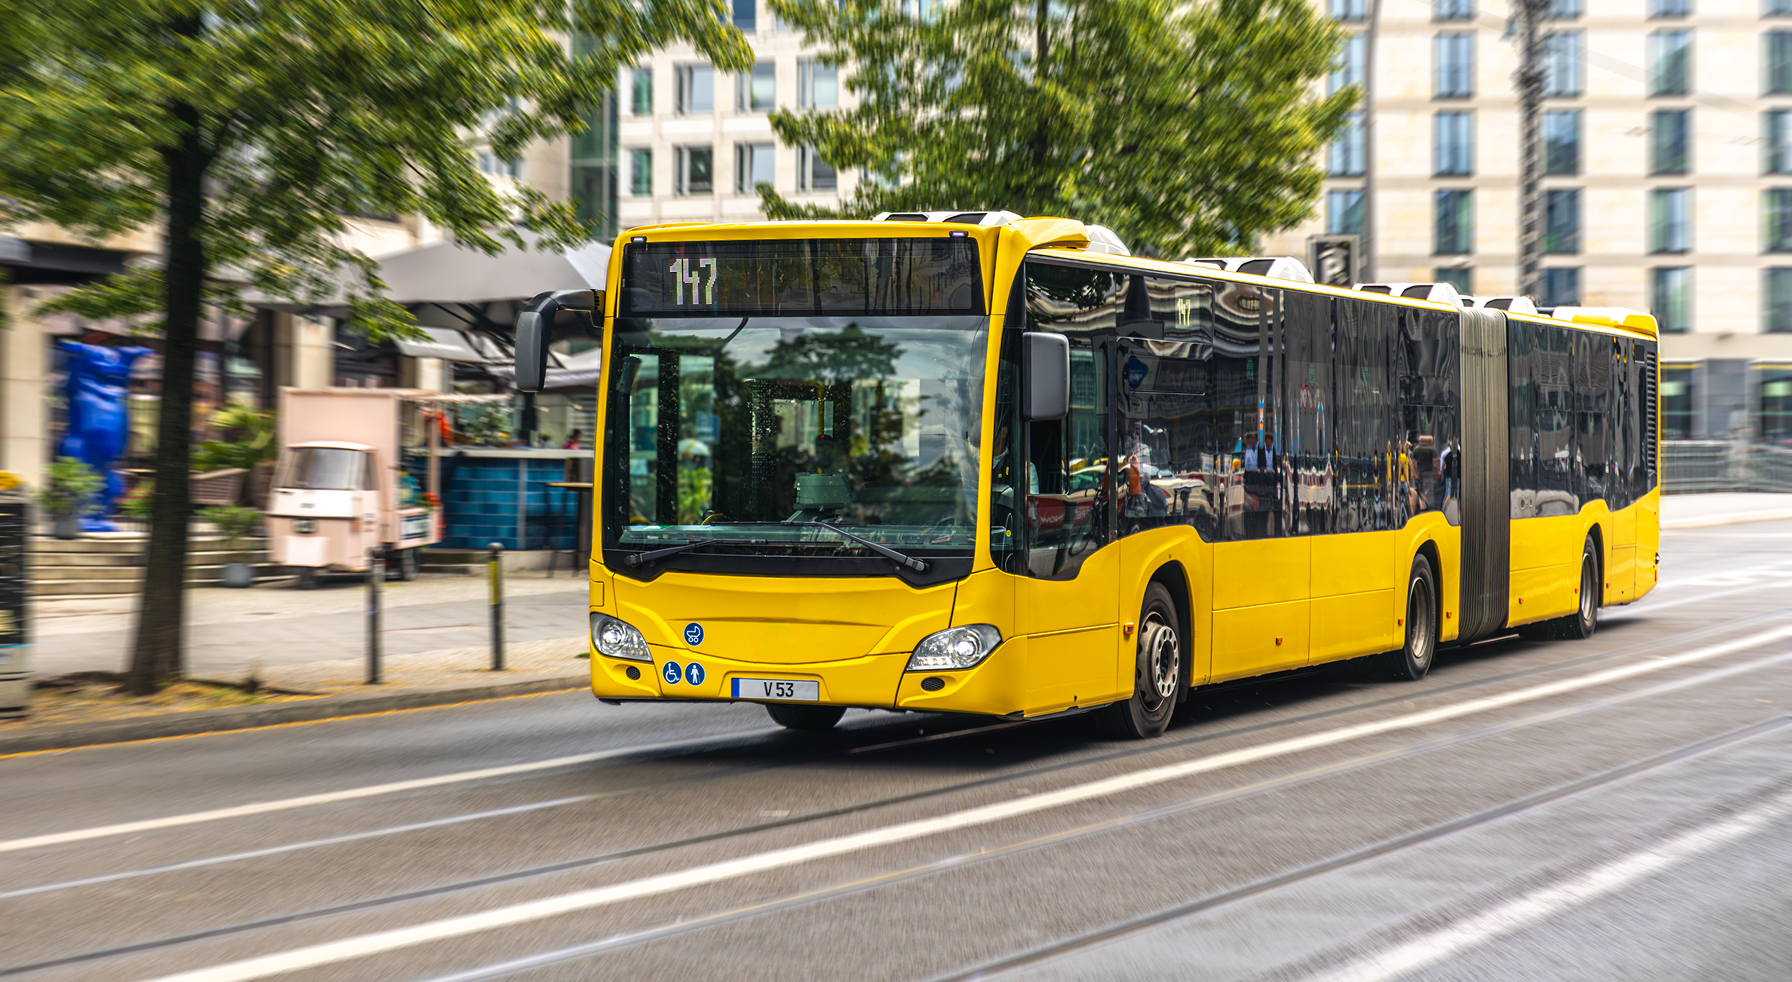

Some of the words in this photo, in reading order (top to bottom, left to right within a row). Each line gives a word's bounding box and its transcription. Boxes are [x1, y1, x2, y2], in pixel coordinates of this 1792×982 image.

[669, 257, 717, 306] 147
[1176, 298, 1191, 327] 147
[763, 681, 773, 697] V
[776, 682, 794, 698] 53
